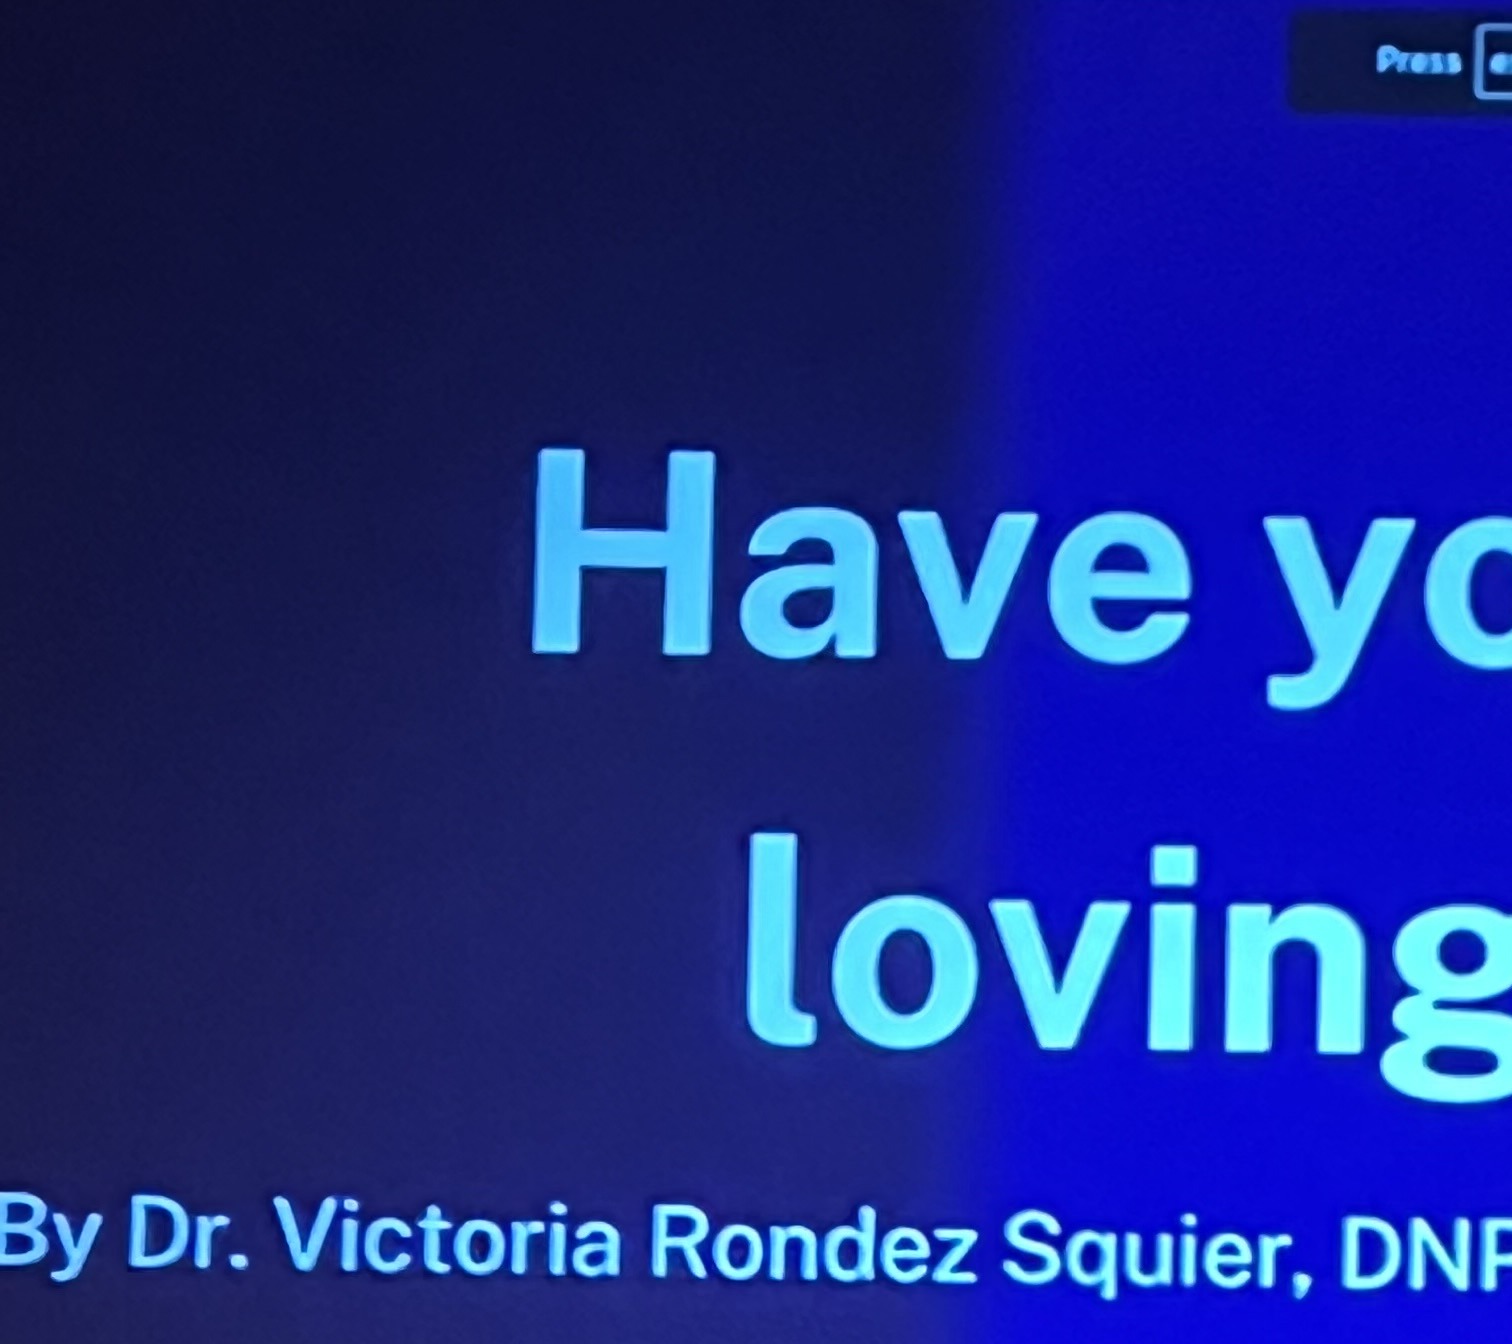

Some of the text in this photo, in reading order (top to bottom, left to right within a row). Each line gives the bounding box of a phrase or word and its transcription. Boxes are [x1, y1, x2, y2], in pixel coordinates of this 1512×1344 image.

[1375, 44, 1463, 76] Press
[531, 447, 1193, 666] Have
[0, 1191, 104, 1283] By
[128, 1194, 249, 1271] Dr.
[272, 1195, 622, 1278] Victoria
[651, 1203, 979, 1285] Rondez
[1002, 1208, 1313, 1302] Squier,
